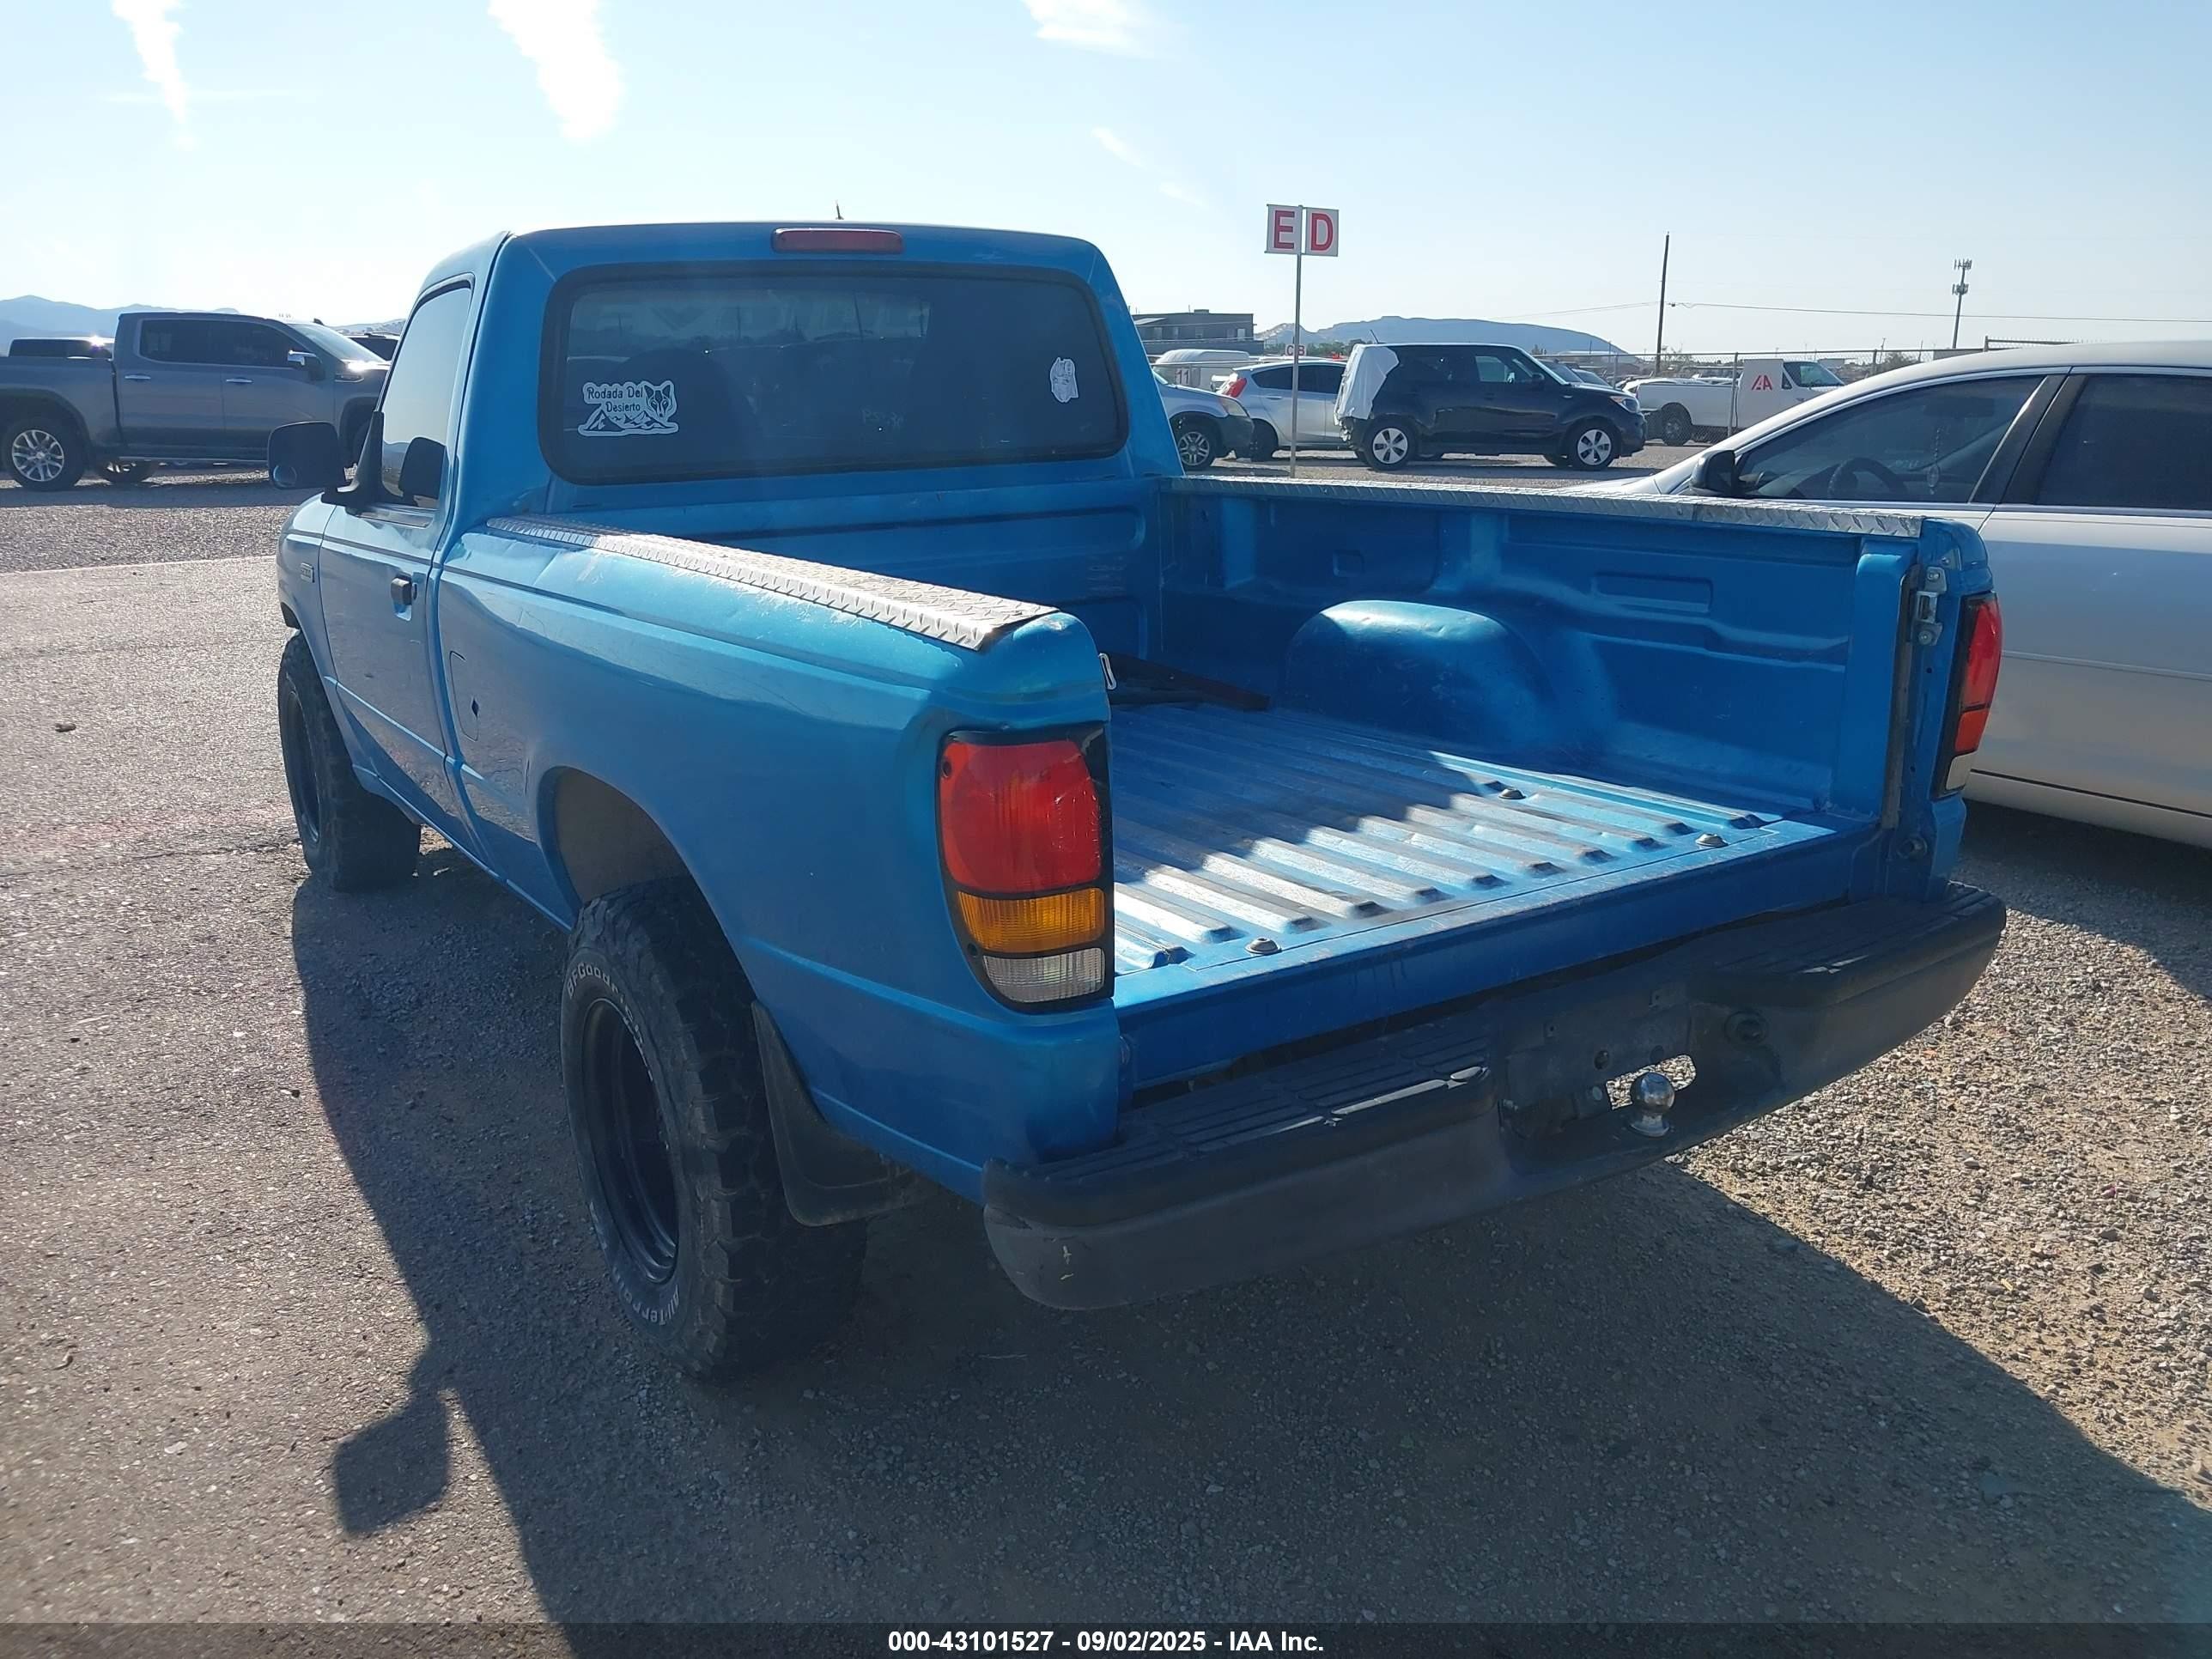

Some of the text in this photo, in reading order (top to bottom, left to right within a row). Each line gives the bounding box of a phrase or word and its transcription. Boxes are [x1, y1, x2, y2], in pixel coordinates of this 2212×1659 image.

[1273, 210, 1334, 251] E D
[586, 386, 643, 399] Rodada Del
[605, 400, 641, 412] Desierto
